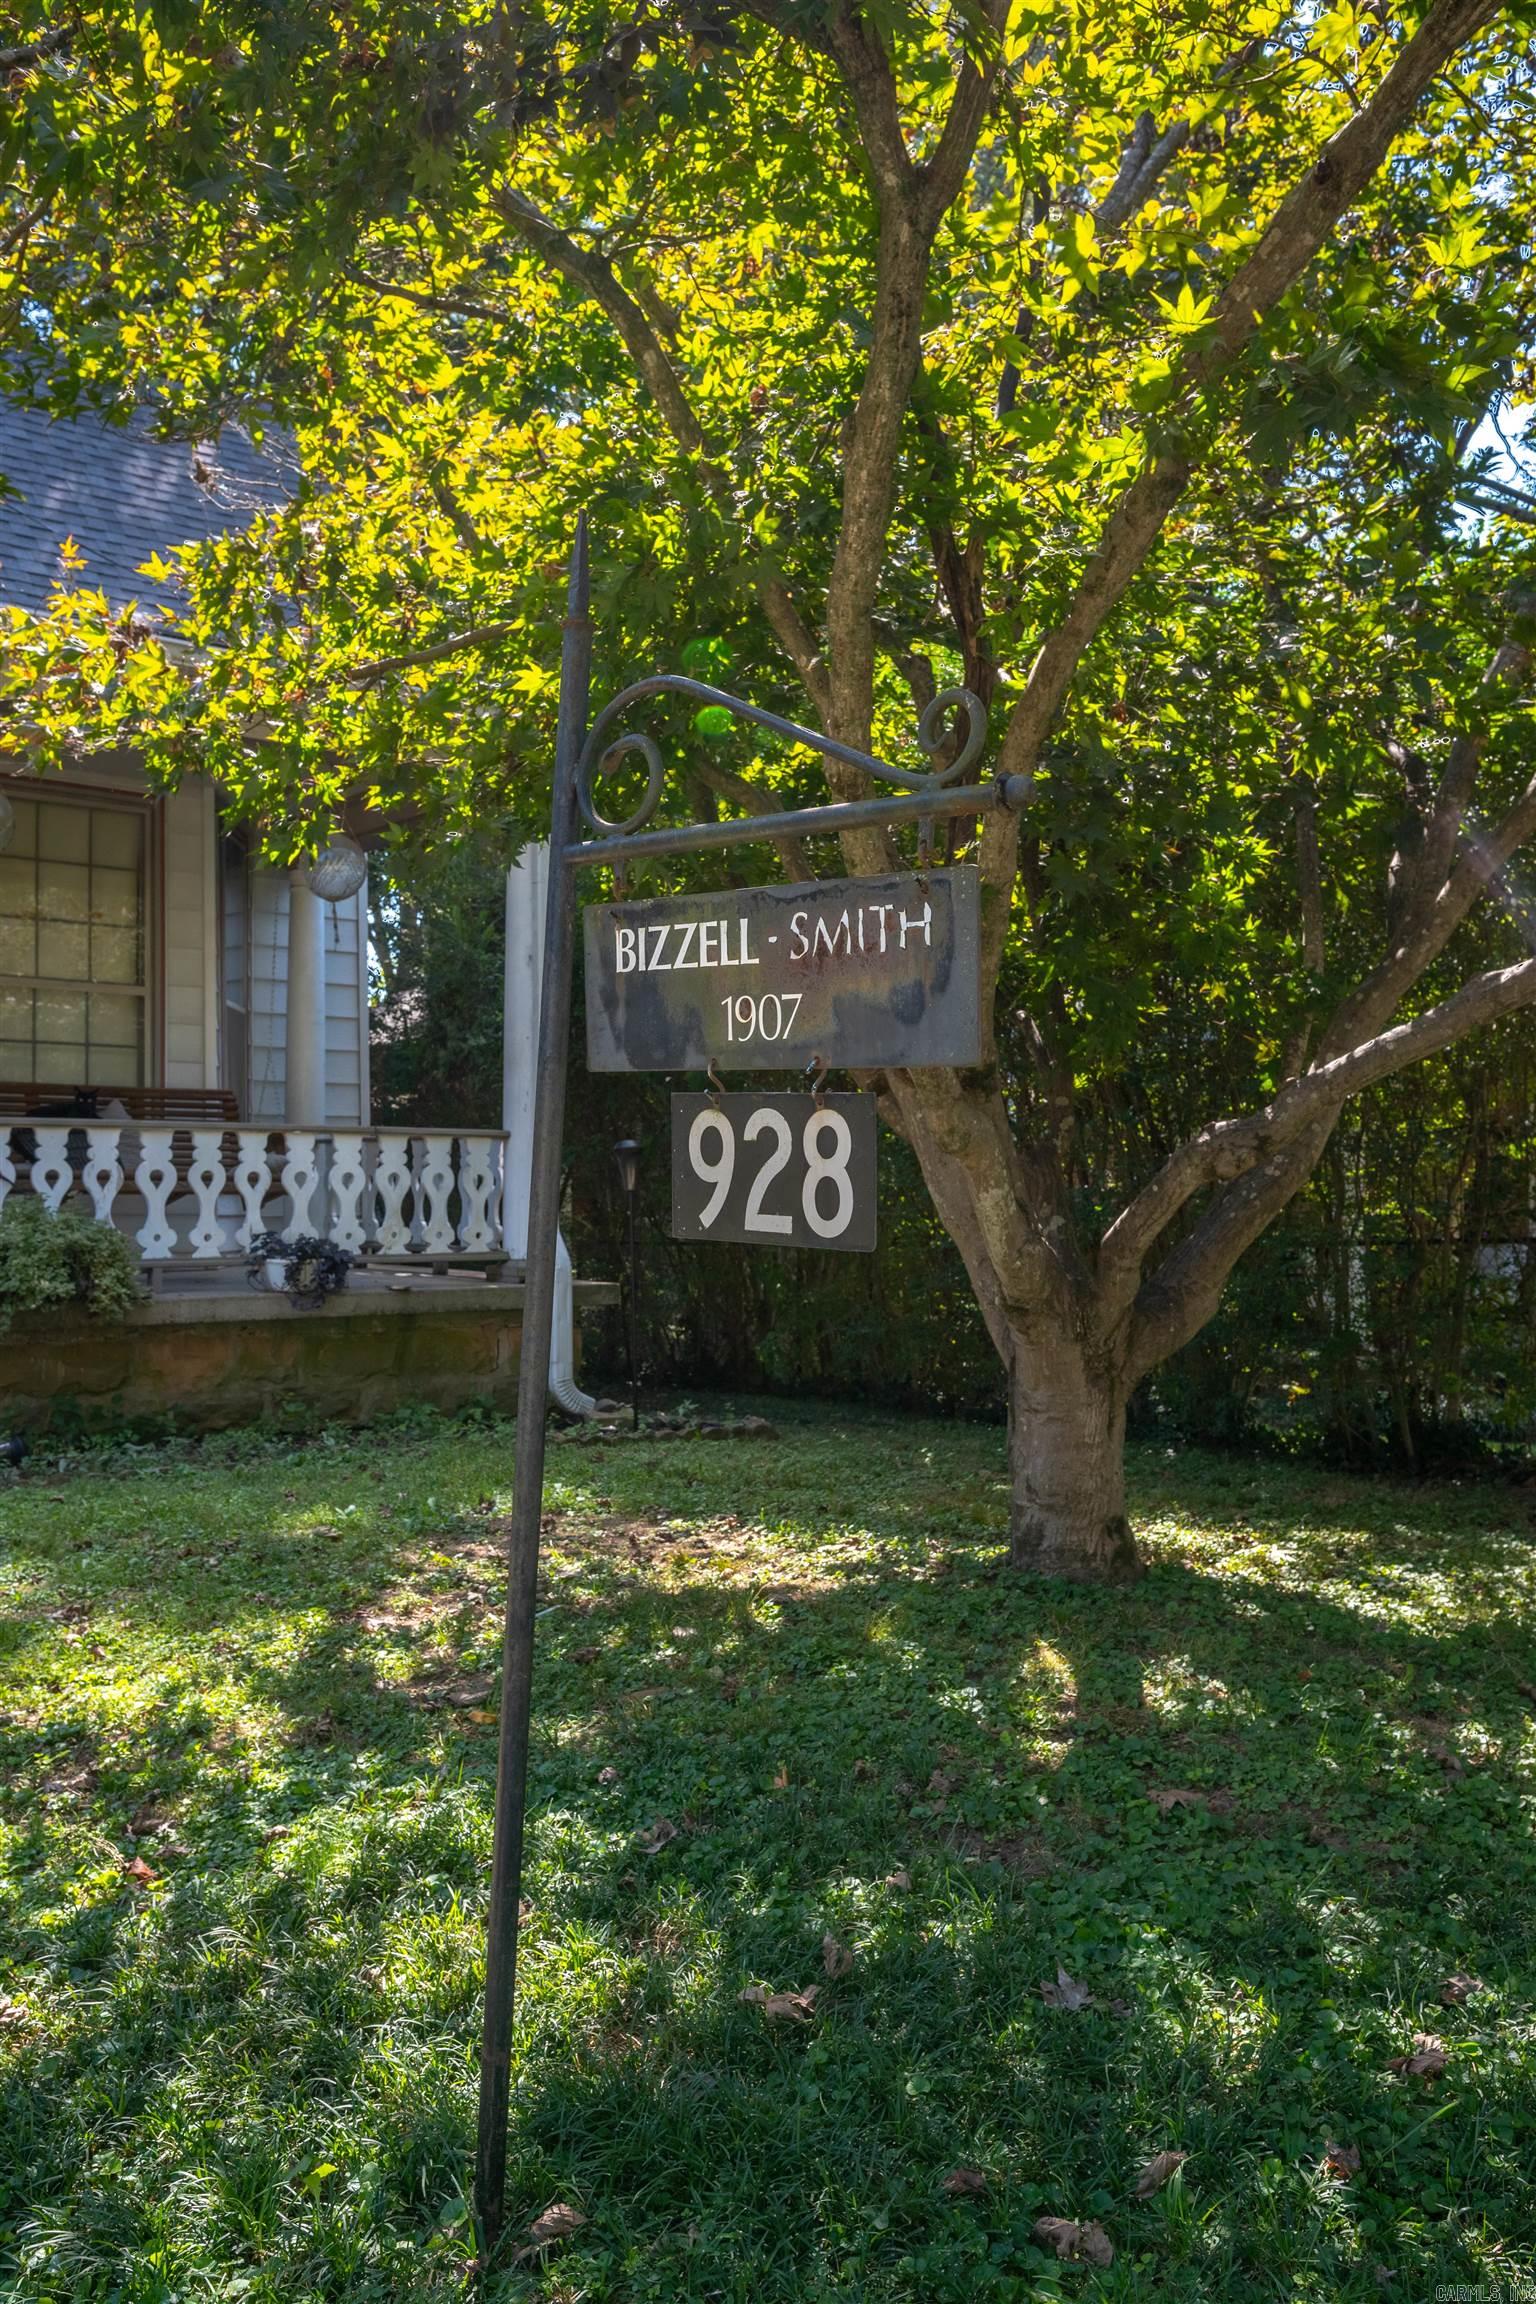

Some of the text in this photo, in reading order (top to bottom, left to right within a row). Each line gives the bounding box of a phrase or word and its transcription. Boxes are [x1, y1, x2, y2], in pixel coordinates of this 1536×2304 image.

[616, 918, 759, 973] BIZZELL
[789, 902, 931, 960] SMITH
[721, 993, 803, 1041] 1907
[688, 1107, 854, 1238] 928
